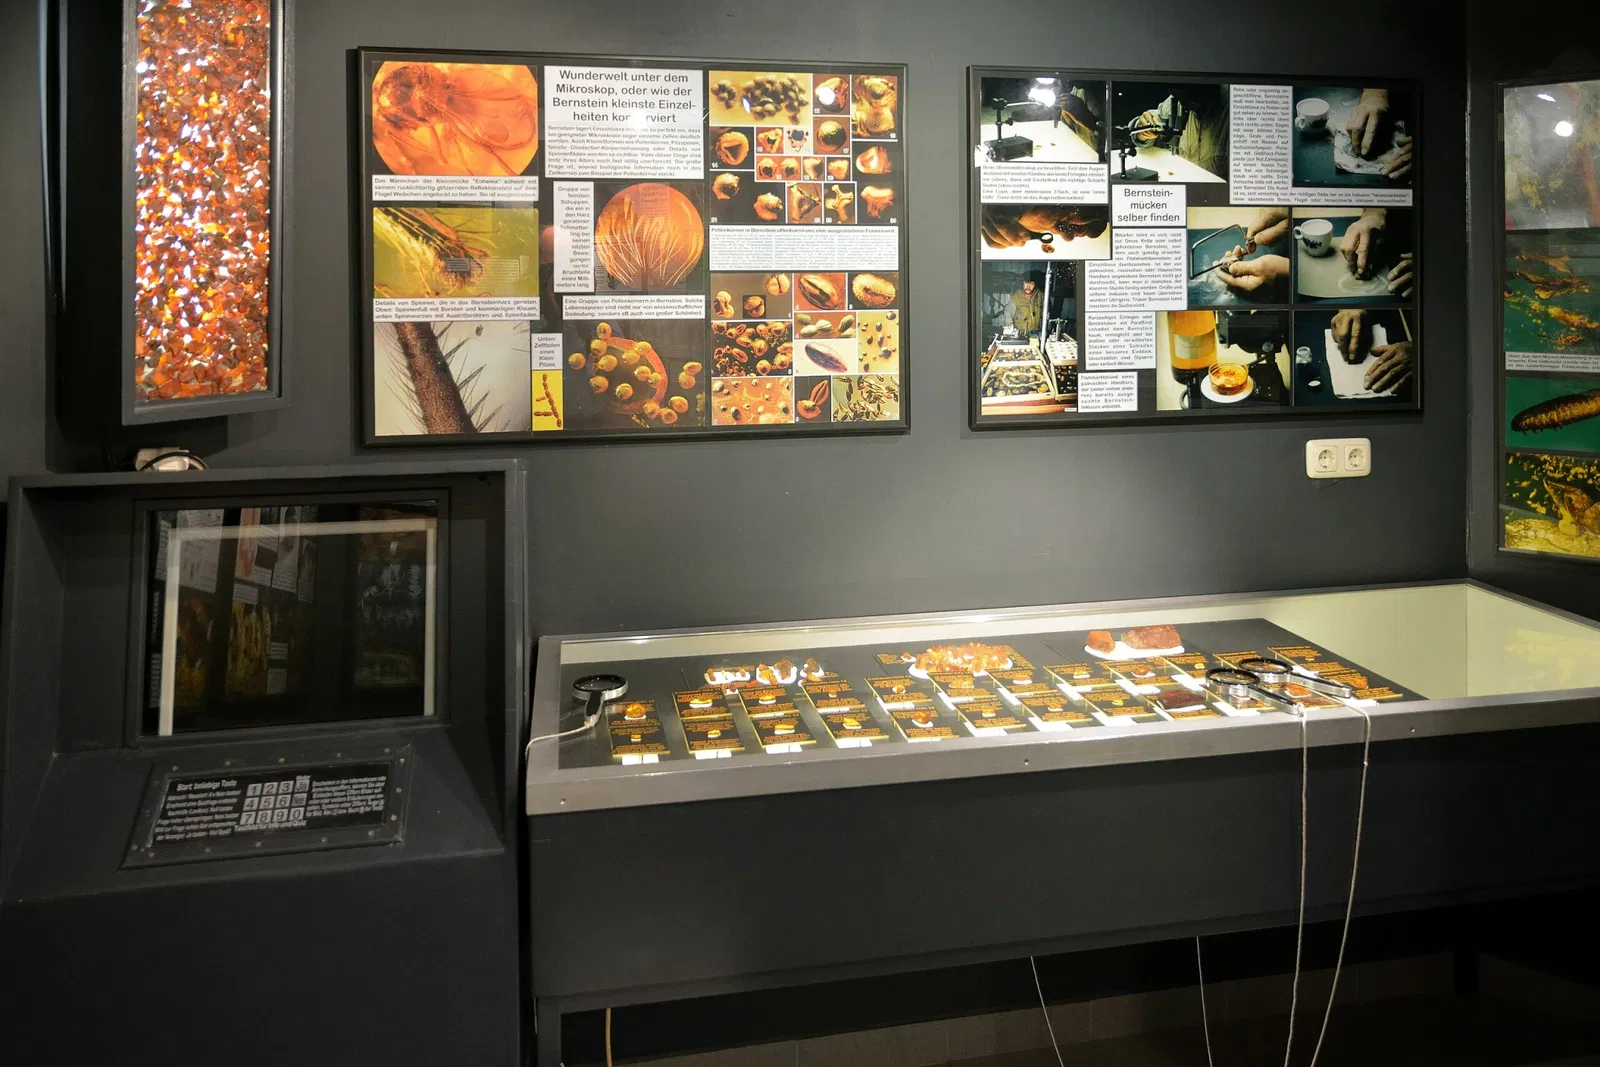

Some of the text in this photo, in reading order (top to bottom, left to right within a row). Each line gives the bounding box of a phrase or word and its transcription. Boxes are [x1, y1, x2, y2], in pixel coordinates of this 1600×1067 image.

[559, 70, 688, 82] Wunderwelt unter dem
[556, 84, 692, 96] Mikroskop, oder wie der
[552, 97, 696, 110] Bernstein kleinste Einzel-
[573, 112, 608, 121] heiten
[1124, 188, 1174, 197] Bernstein-
[1130, 201, 1167, 209] mücken
[1117, 213, 1180, 222] selber finden
[251, 785, 256, 795] 1
[267, 784, 274, 794] 2
[282, 782, 289, 792] 3
[296, 781, 307, 791] Ja
[246, 800, 254, 809] 4
[263, 798, 272, 807] 5
[279, 796, 288, 807] 6
[245, 814, 252, 823] 7
[260, 812, 268, 822] 8
[276, 811, 284, 820] 9
[293, 810, 301, 819] 0
